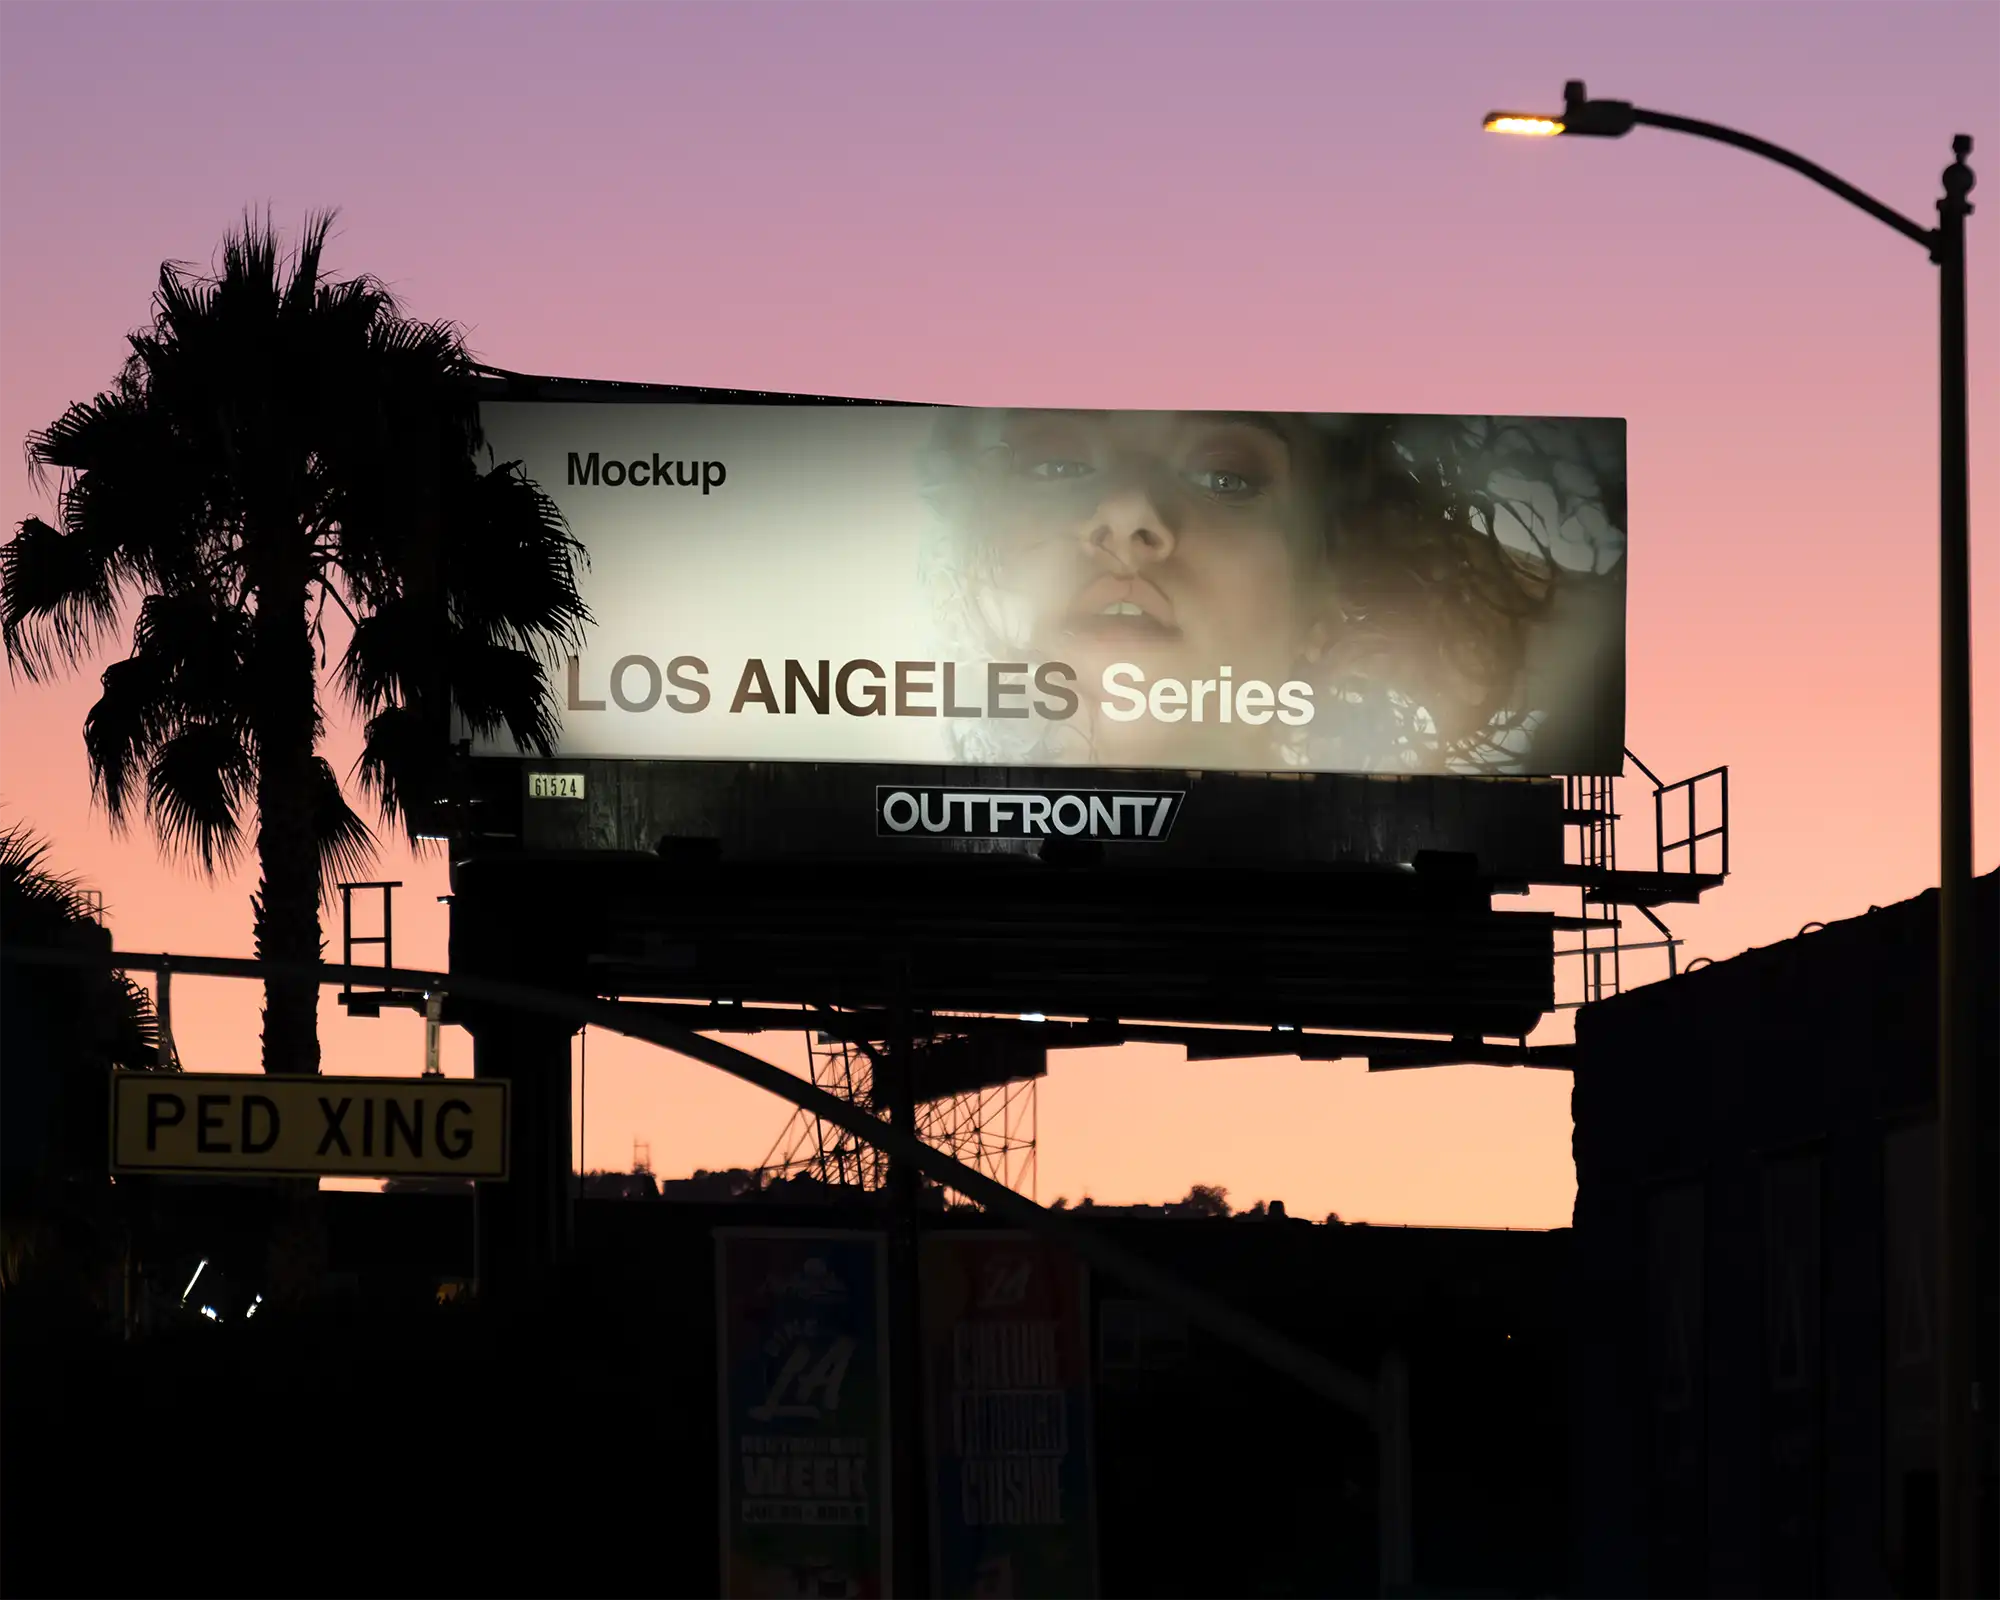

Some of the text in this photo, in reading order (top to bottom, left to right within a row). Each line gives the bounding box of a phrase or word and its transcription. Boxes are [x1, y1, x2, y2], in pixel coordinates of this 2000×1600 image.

[567, 451, 727, 495] Mockup
[567, 654, 1316, 726] LOS ANGELES Series
[535, 778, 577, 797] 61524
[146, 1093, 474, 1160] PED XING
[742, 1455, 868, 1497] WEEK
